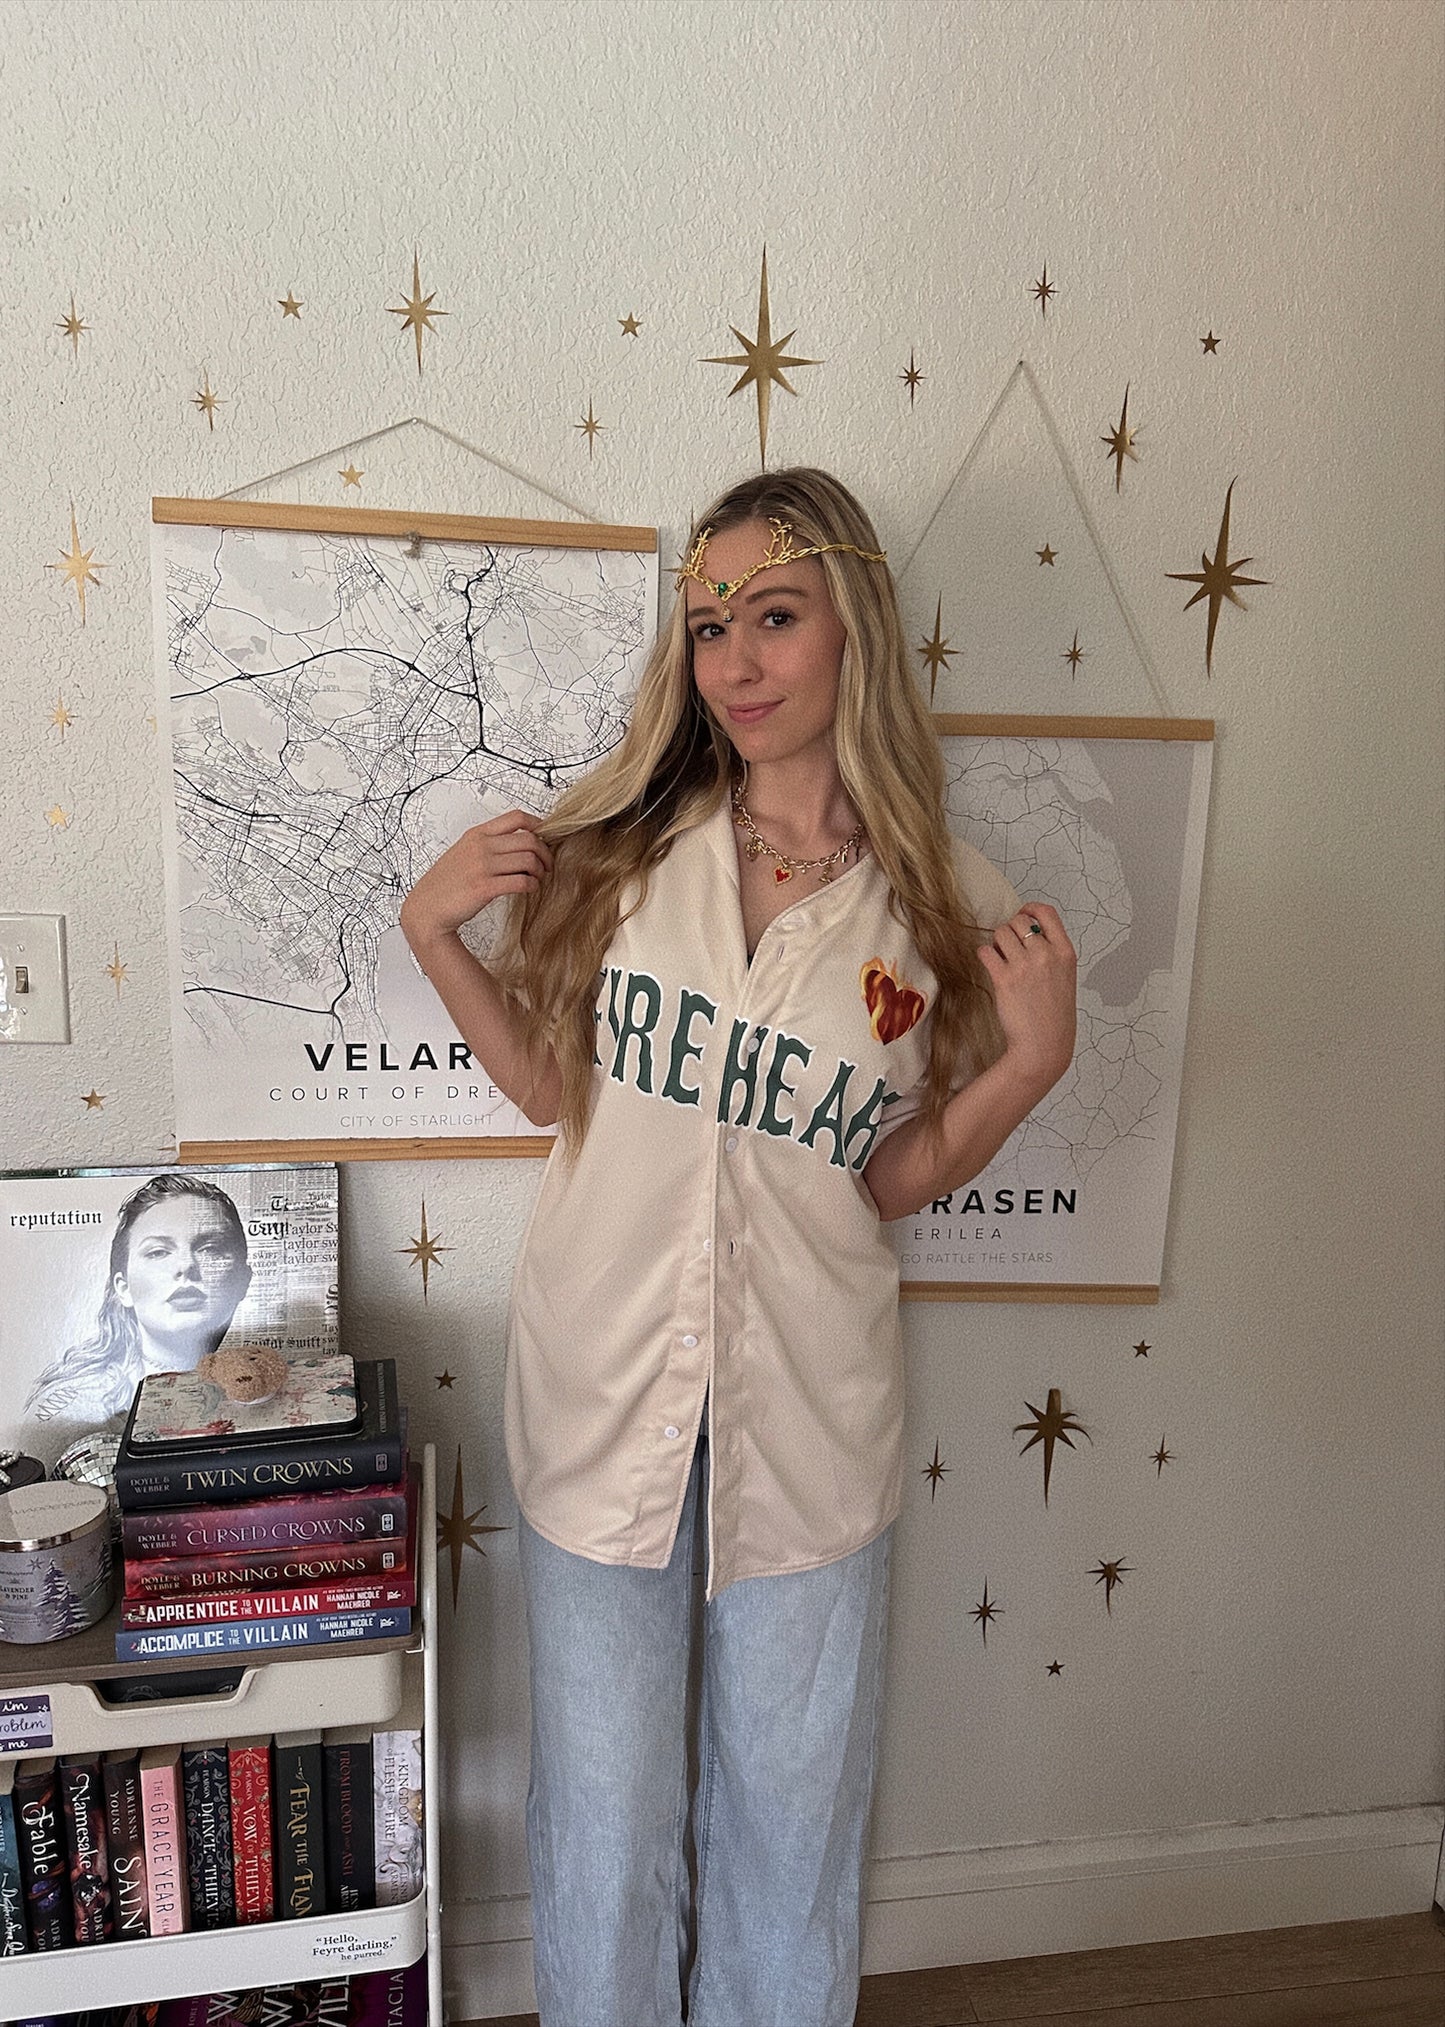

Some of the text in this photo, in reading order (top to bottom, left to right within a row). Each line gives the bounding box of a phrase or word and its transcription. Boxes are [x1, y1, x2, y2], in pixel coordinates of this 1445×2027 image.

[304, 1043, 473, 1072] VELAR
[269, 1085, 498, 1101] COURT OF DRE
[340, 1113, 494, 1128] CITY OF STARLIGHT
[915, 1189, 1077, 1214] RASEN
[10, 1210, 102, 1230] reputation
[283, 1237, 319, 1253] taylor
[914, 1228, 1002, 1240] ERILEA
[283, 1252, 319, 1268] taylor
[900, 1252, 1054, 1264] GO RATTLE THE STARS
[131, 1476, 159, 1486] DOYLE
[181, 1457, 354, 1491] TWIN CROWNS
[135, 1484, 170, 1494] WEBBER
[138, 1533, 166, 1543] DOYLE
[187, 1516, 366, 1546] CURSED CROWNS
[142, 1541, 177, 1550] WEBBER
[141, 1575, 169, 1585] DOYLE
[192, 1557, 366, 1587] BURNING CROWNS
[145, 1582, 180, 1591] WEBBER
[326, 1591, 355, 1602] HANNAH
[357, 1590, 380, 1600] NICOLE
[146, 1594, 319, 1623] APPRENTICE TO THE VILLAIN
[336, 1600, 371, 1610] MAEHRER
[320, 1618, 374, 1631] HANNAH NICOLE
[330, 1628, 364, 1638] MAEHRER
[139, 1623, 309, 1654] ACCOMPLICE TO THE VILLAIN
[8, 1740, 28, 1750] me
[339, 1750, 351, 1787] FROM
[384, 1757, 396, 1795] FLESH
[153, 1780, 164, 1798] THE
[202, 1769, 212, 1799] PEARSON
[245, 1770, 254, 1800] PEARSON
[398, 1764, 409, 1827] KINGDOM
[69, 1773, 99, 1869] Namesake
[109, 1790, 121, 1835] YOUNG
[125, 1778, 139, 1841] ADRIENNE
[286, 1781, 311, 1838] FEAR
[340, 1790, 353, 1834] BLOOD
[22, 1801, 58, 1875] Fable
[150, 1802, 172, 1864] GRACE
[200, 1802, 217, 1855] DANCE
[242, 1806, 258, 1843] VOW
[384, 1811, 396, 1840] FIRE
[297, 1838, 310, 1866] THE
[342, 1850, 356, 1876] ASH
[154, 1869, 175, 1914] YEAR
[312, 1945, 345, 1957] Feyre
[341, 1949, 385, 1961] he purred.
